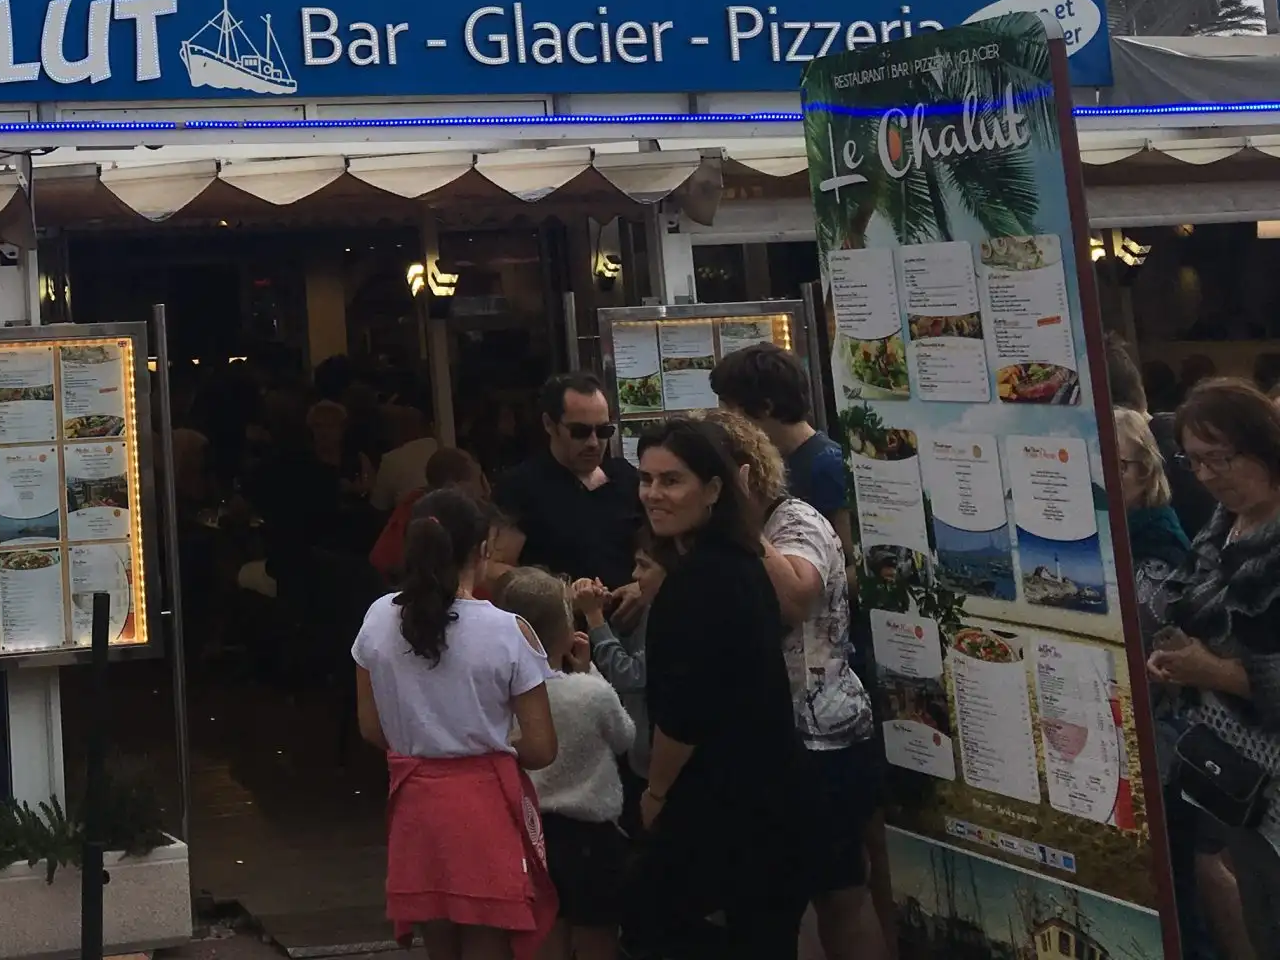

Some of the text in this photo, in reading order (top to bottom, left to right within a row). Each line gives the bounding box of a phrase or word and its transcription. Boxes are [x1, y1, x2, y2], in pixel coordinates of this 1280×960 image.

[301, 6, 409, 65] Bar
[464, 2, 673, 65] Glacier
[833, 43, 1000, 90] RESTAURANT BAR PIZZERIA GLACIER
[819, 81, 1032, 205] Le Chalut
